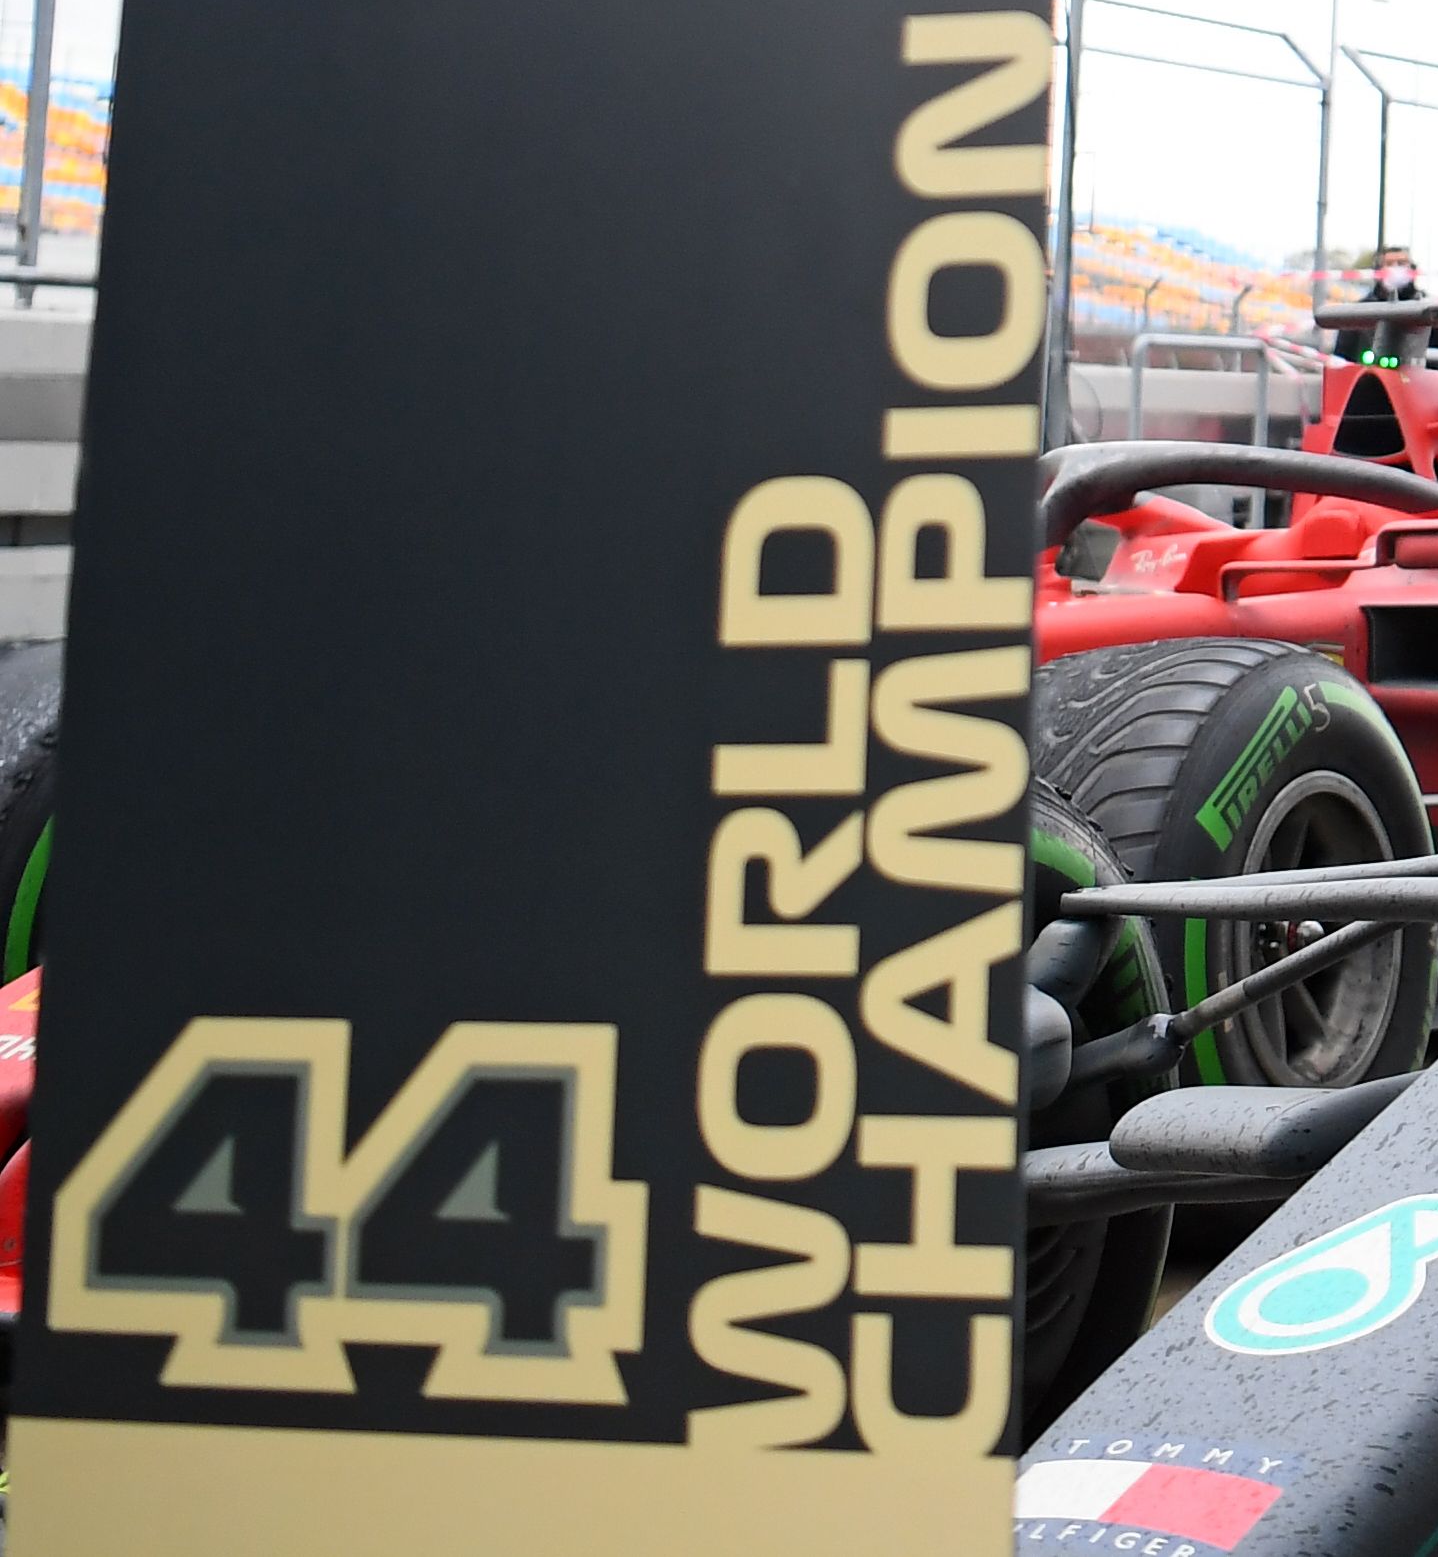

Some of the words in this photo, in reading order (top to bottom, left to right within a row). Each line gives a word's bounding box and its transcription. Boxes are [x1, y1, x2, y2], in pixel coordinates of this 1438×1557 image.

[850, 8, 1055, 1456] CHAMPION
[1194, 685, 1314, 854] PIRELLI
[1303, 682, 1332, 734] 5
[687, 475, 876, 1448] WORLD
[47, 1016, 649, 1405] 44
[1013, 1522, 1196, 1557] LFIGER
[1067, 1438, 1284, 1475] TOMMY
